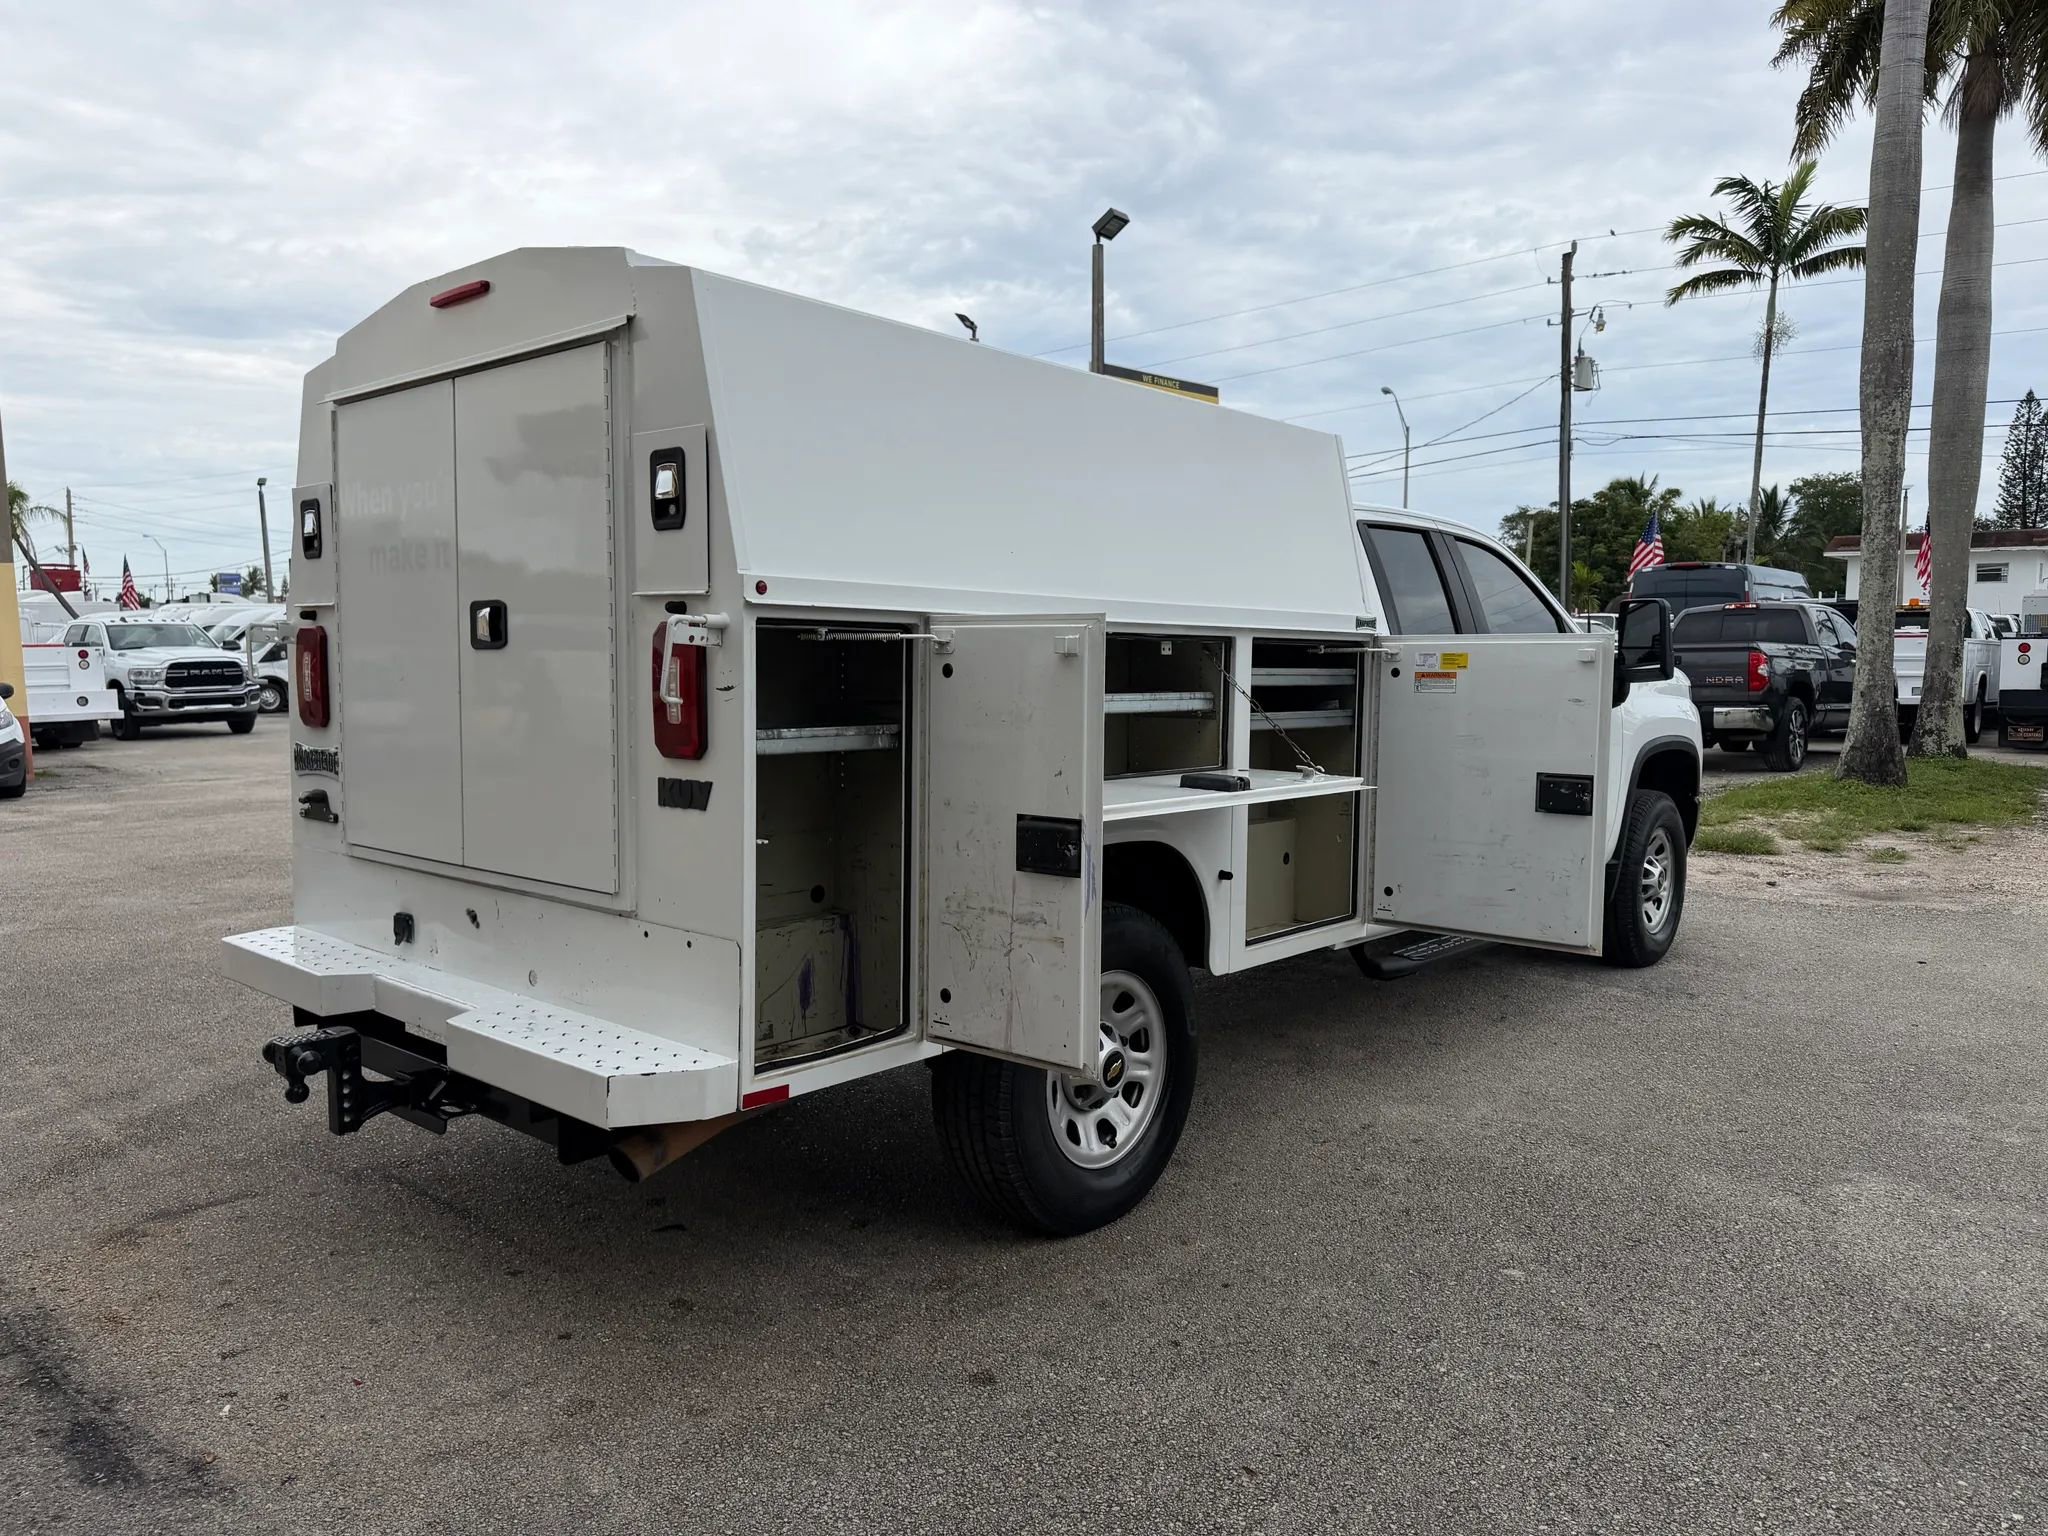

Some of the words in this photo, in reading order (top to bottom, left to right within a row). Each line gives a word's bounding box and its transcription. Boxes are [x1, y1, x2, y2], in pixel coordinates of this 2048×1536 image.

[1142, 374, 1152, 384] WE
[1154, 377, 1180, 389] FINANCE
[339, 480, 393, 517] When
[369, 535, 428, 574] make
[190, 668, 223, 676] RAM
